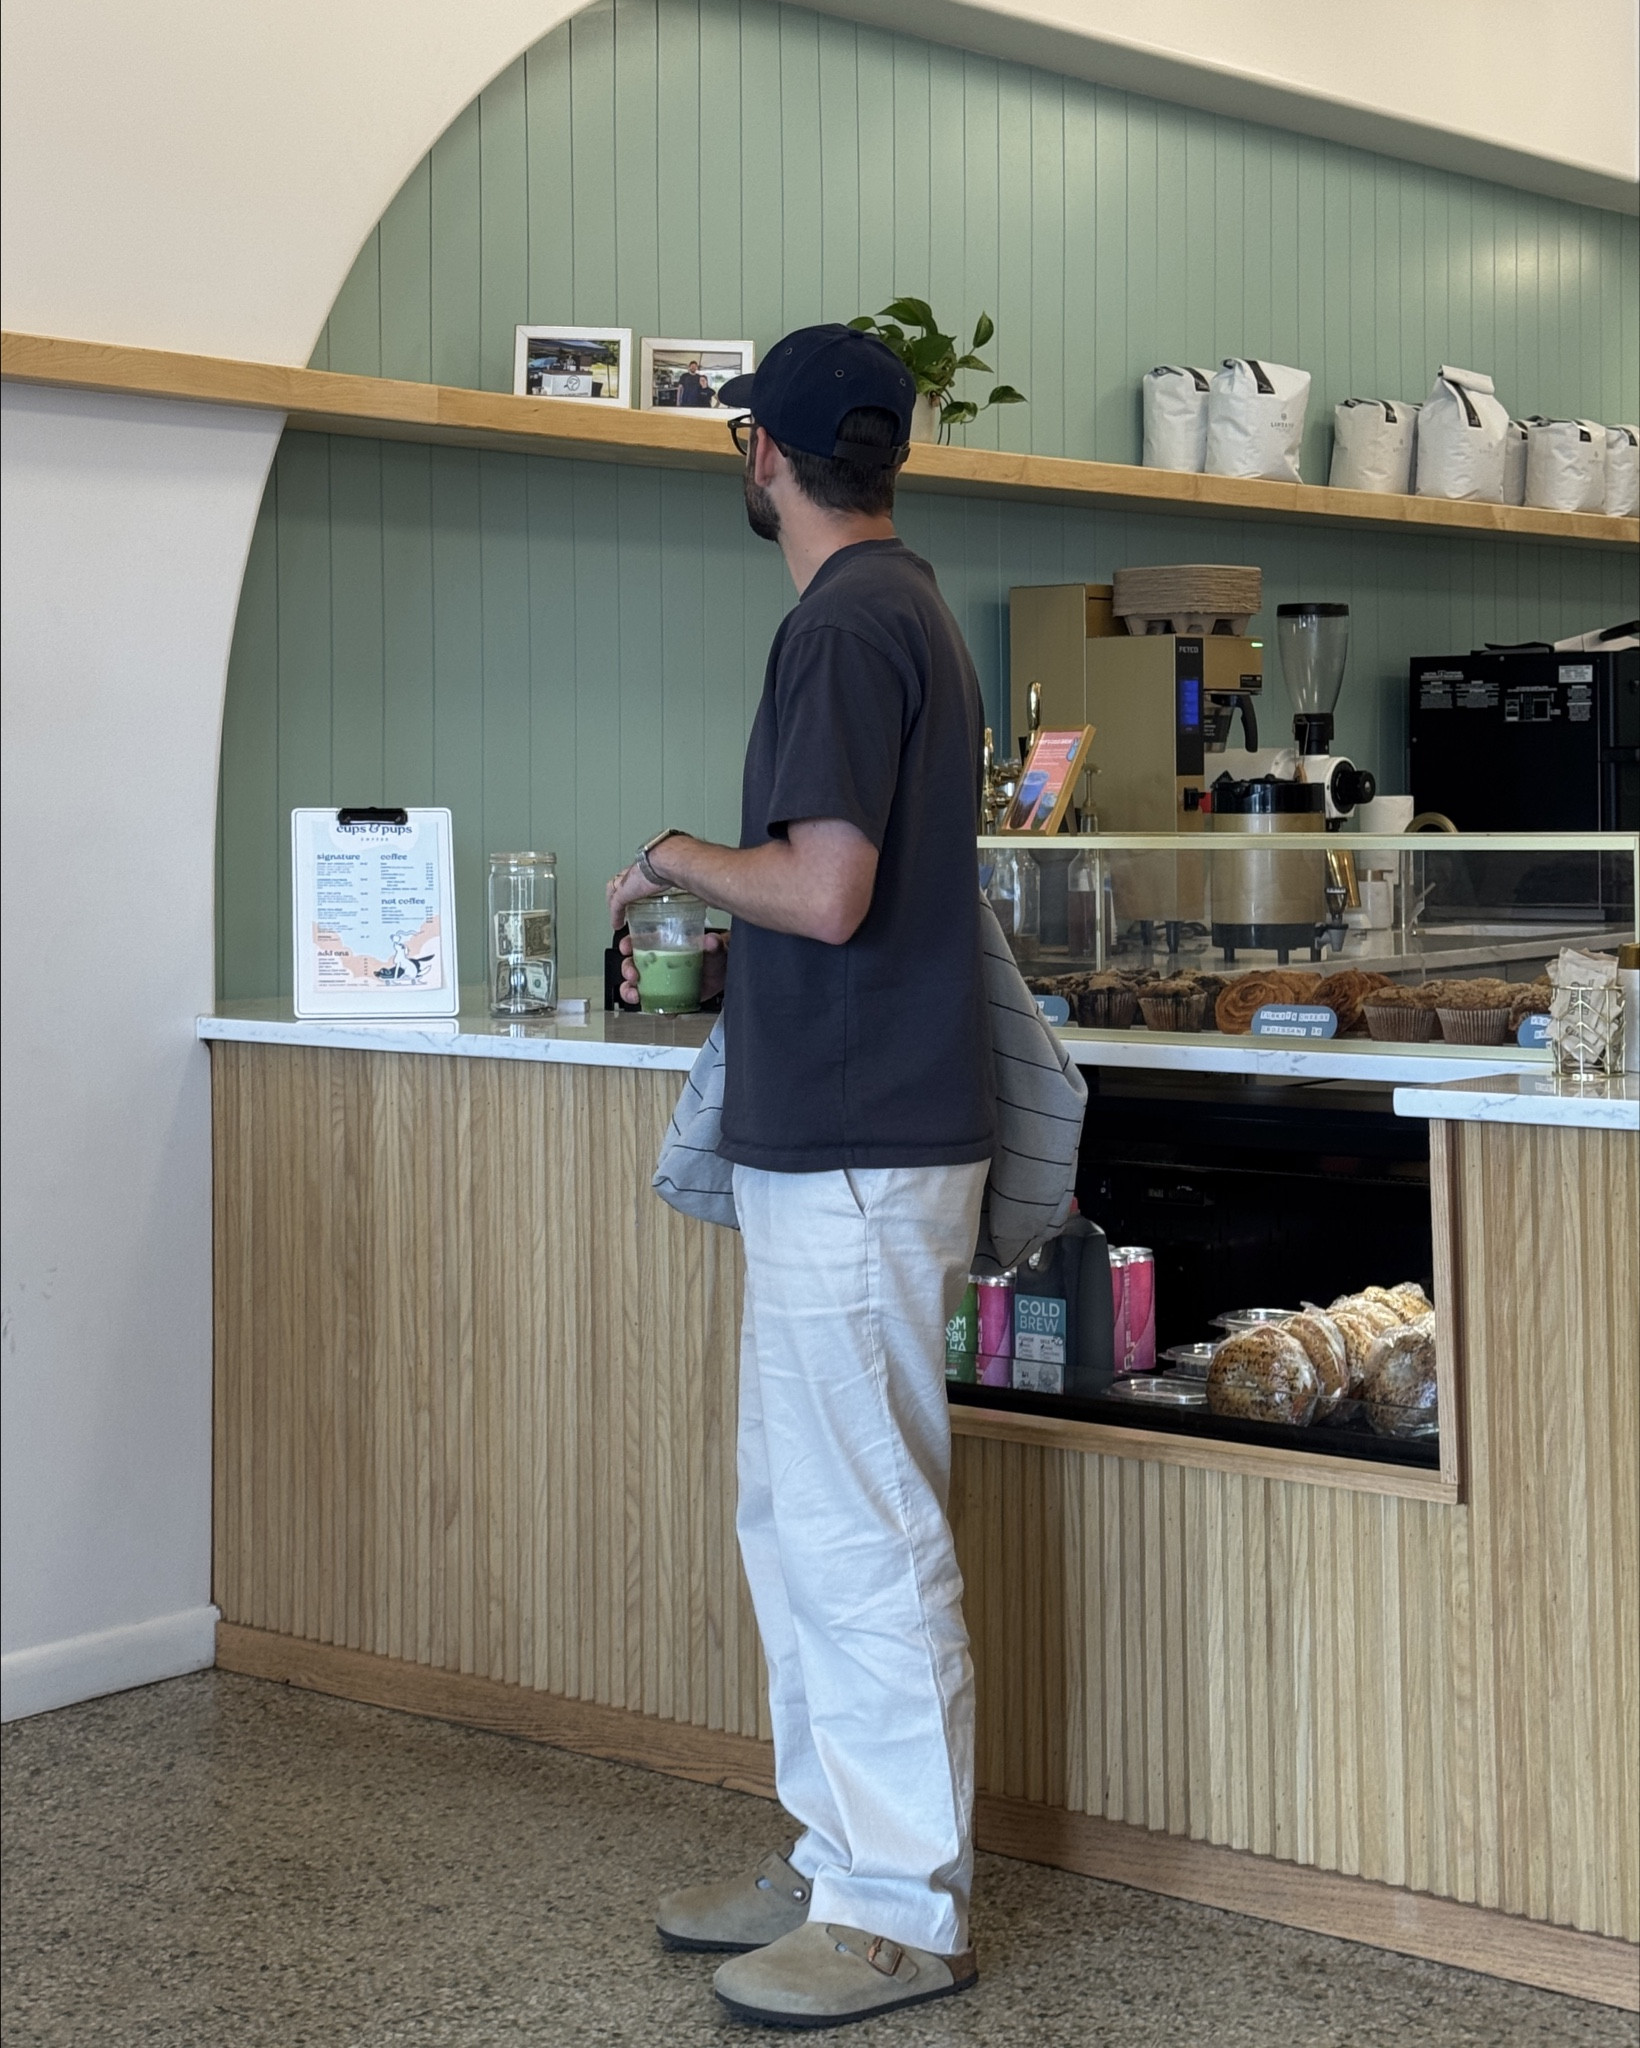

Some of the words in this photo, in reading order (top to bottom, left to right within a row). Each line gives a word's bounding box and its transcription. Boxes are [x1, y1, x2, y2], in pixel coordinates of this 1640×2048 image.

[336, 824, 366, 836] cups
[369, 823, 380, 834] &
[381, 825, 413, 836] pups
[316, 852, 361, 861] signature
[380, 852, 408, 860] coffee
[398, 897, 426, 905] coffee
[1018, 1299, 1060, 1318] COLD
[1020, 1315, 1059, 1333] BREW
